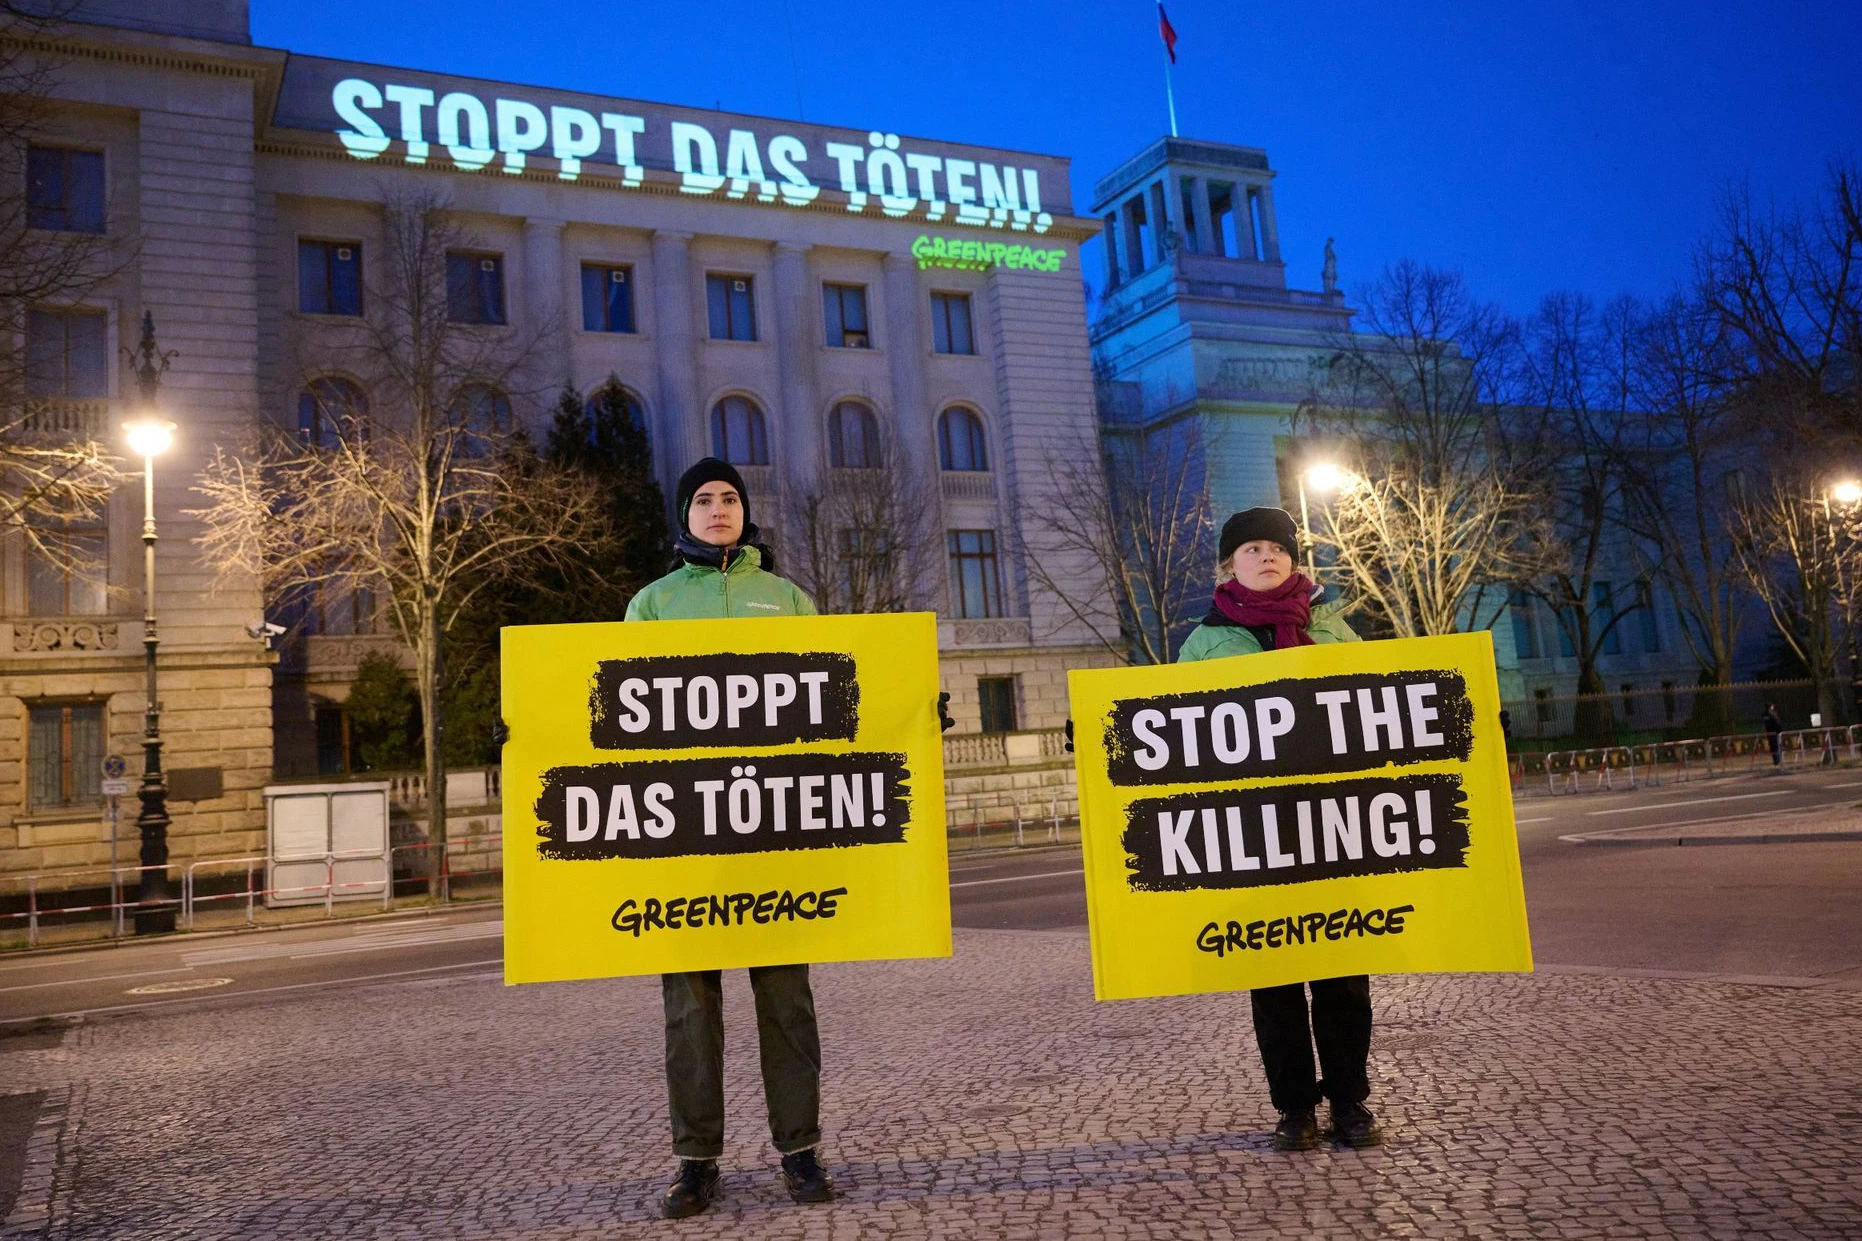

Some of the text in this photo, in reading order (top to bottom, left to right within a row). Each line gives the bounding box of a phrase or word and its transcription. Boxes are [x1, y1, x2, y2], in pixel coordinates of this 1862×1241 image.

[332, 78, 1053, 234] STOPPT DAS TÖTEN!
[911, 234, 1067, 272] GREENPEACE
[618, 671, 829, 733] STOPPT
[1130, 682, 1445, 771] STOP THE
[565, 765, 887, 843] DAS TÖTEN!
[1157, 789, 1436, 877] KILLING!
[611, 886, 848, 938] GREENPEACE
[1196, 904, 1415, 957] GREENPEACE
